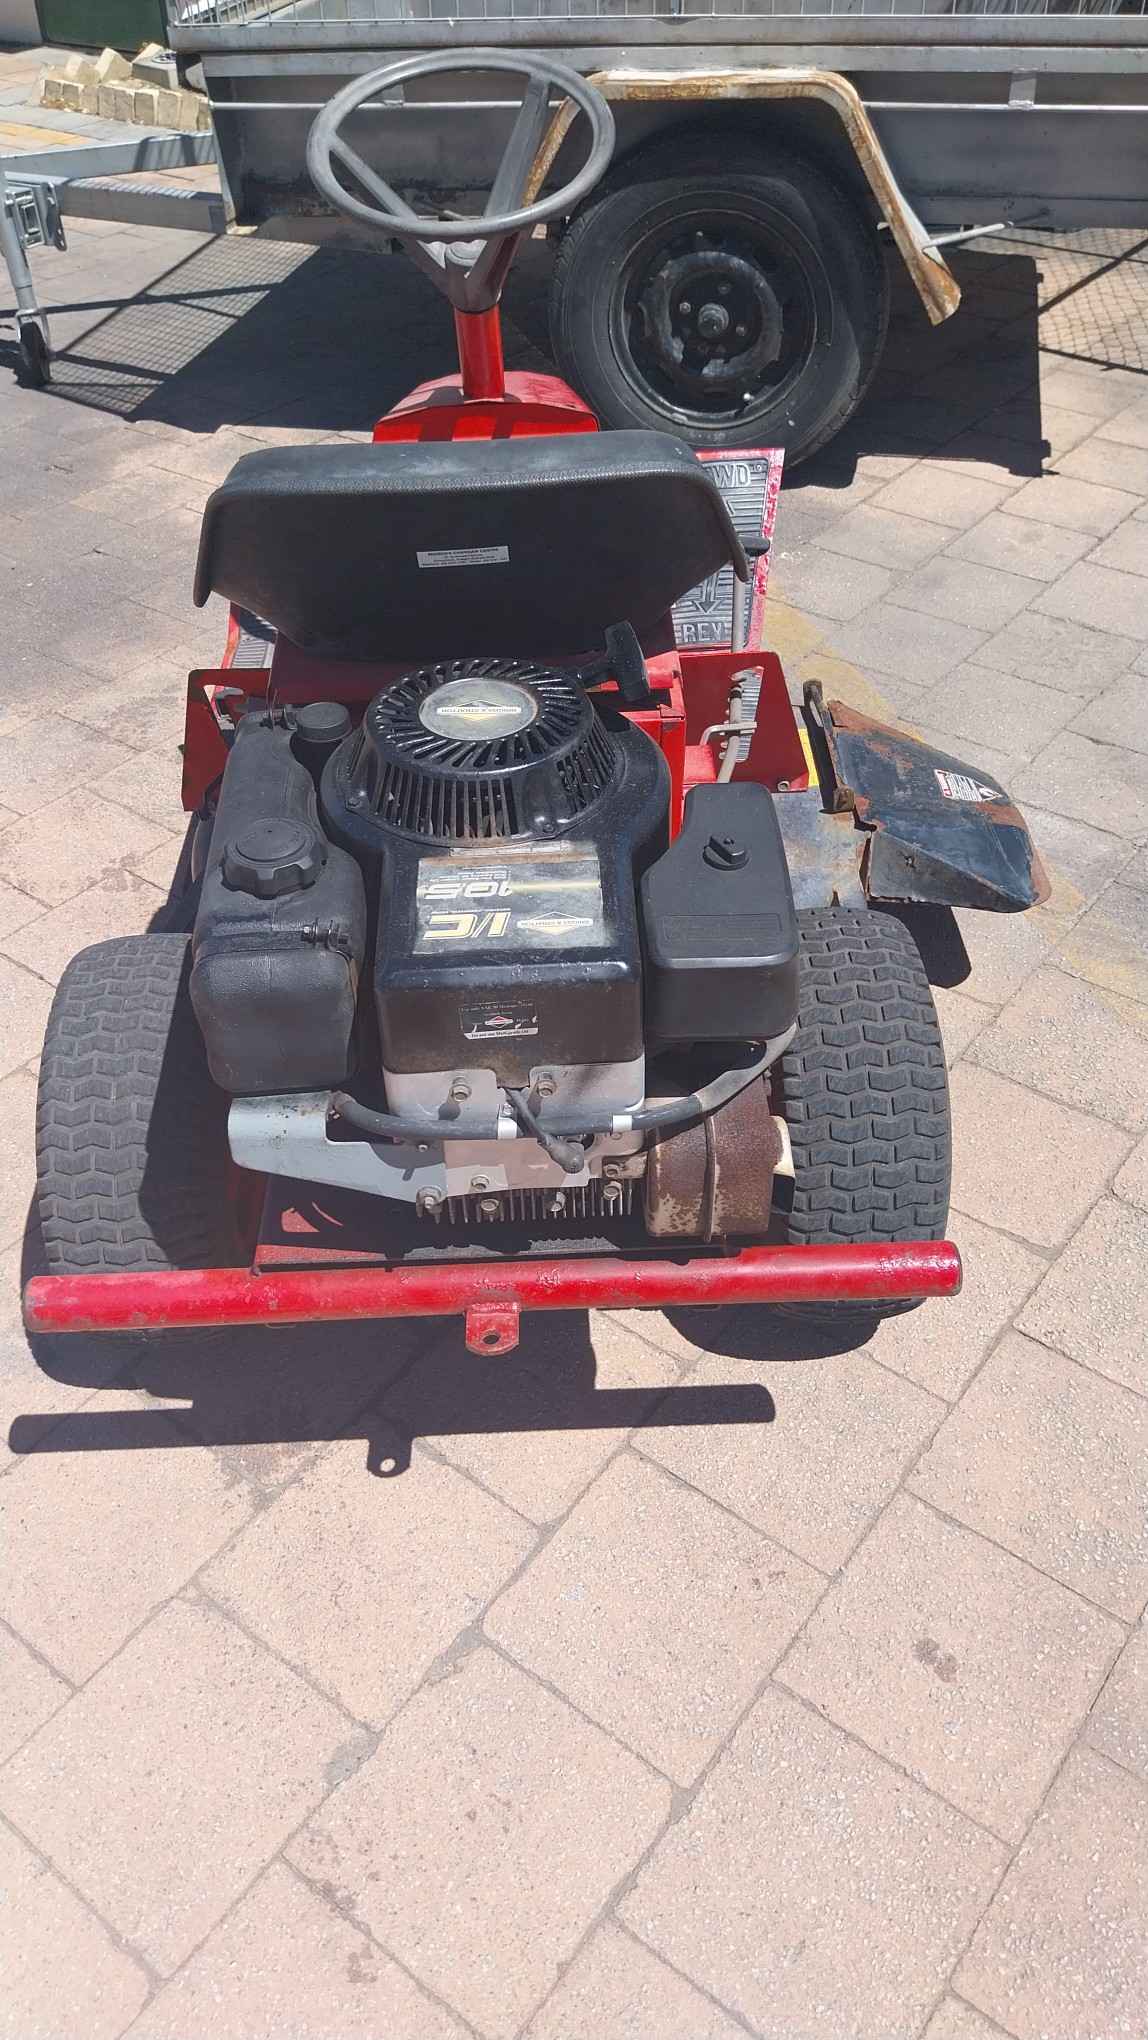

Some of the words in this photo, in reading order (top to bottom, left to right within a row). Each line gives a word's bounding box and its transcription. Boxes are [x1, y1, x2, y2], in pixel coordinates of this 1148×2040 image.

[703, 463, 751, 488] WD
[682, 622, 723, 642] REV
[423, 911, 512, 940] I/C
